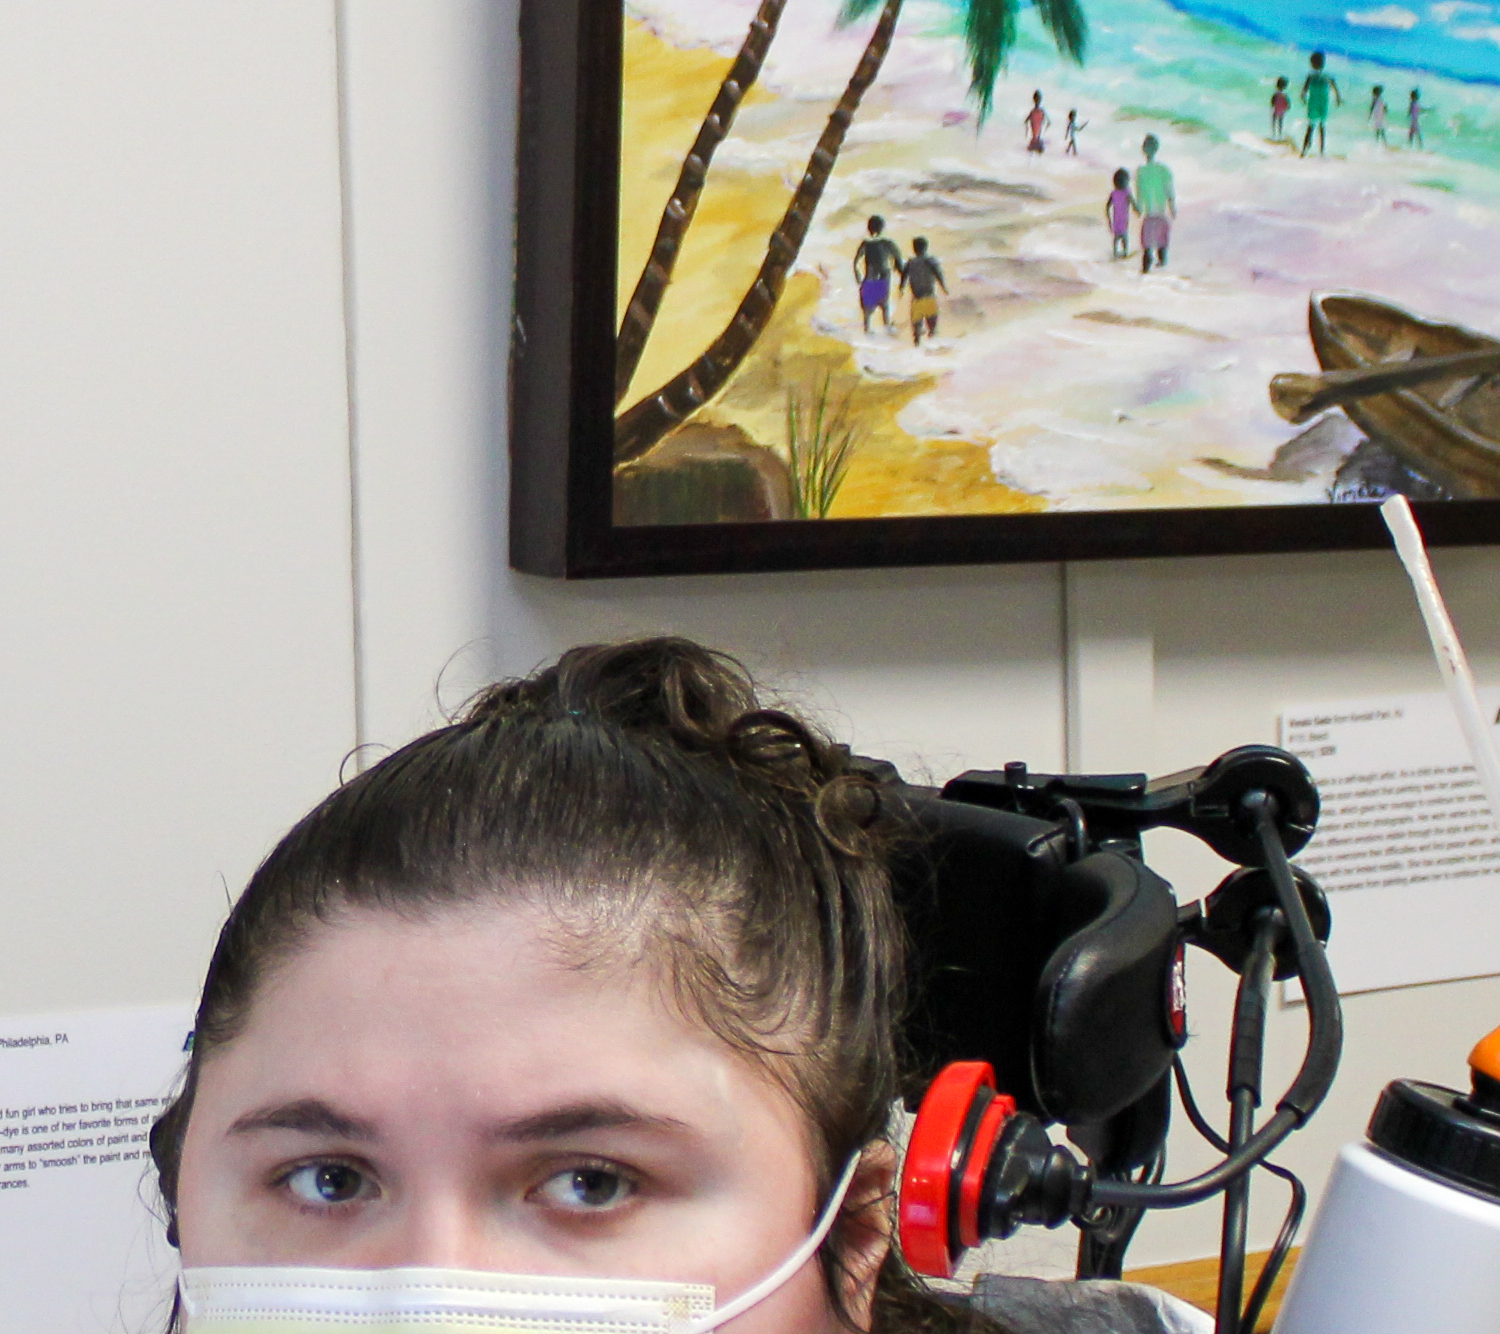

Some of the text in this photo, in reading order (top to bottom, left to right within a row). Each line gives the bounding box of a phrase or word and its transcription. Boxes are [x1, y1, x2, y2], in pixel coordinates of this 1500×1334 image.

[55, 1033, 68, 1043] PA
[5, 1108, 19, 1118] fun
[22, 1106, 35, 1119] girl
[37, 1106, 56, 1115] who
[58, 1104, 77, 1114] tries
[79, 1102, 88, 1112] to
[91, 1101, 112, 1111] bring
[115, 1098, 132, 1109] that
[134, 1098, 161, 1107] same
[21, 1125, 29, 1134] is
[31, 1125, 48, 1134] one
[50, 1121, 59, 1132] of
[61, 1121, 76, 1130] her
[78, 1118, 111, 1129] favorite
[113, 1116, 138, 1126] forms
[140, 1113, 152, 1124] of
[0, 1145, 24, 1154] many
[27, 1139, 64, 1151] assorted
[67, 1138, 93, 1148] colors
[96, 1134, 105, 1145] of
[107, 1133, 128, 1146] paint
[130, 1130, 146, 1142] and
